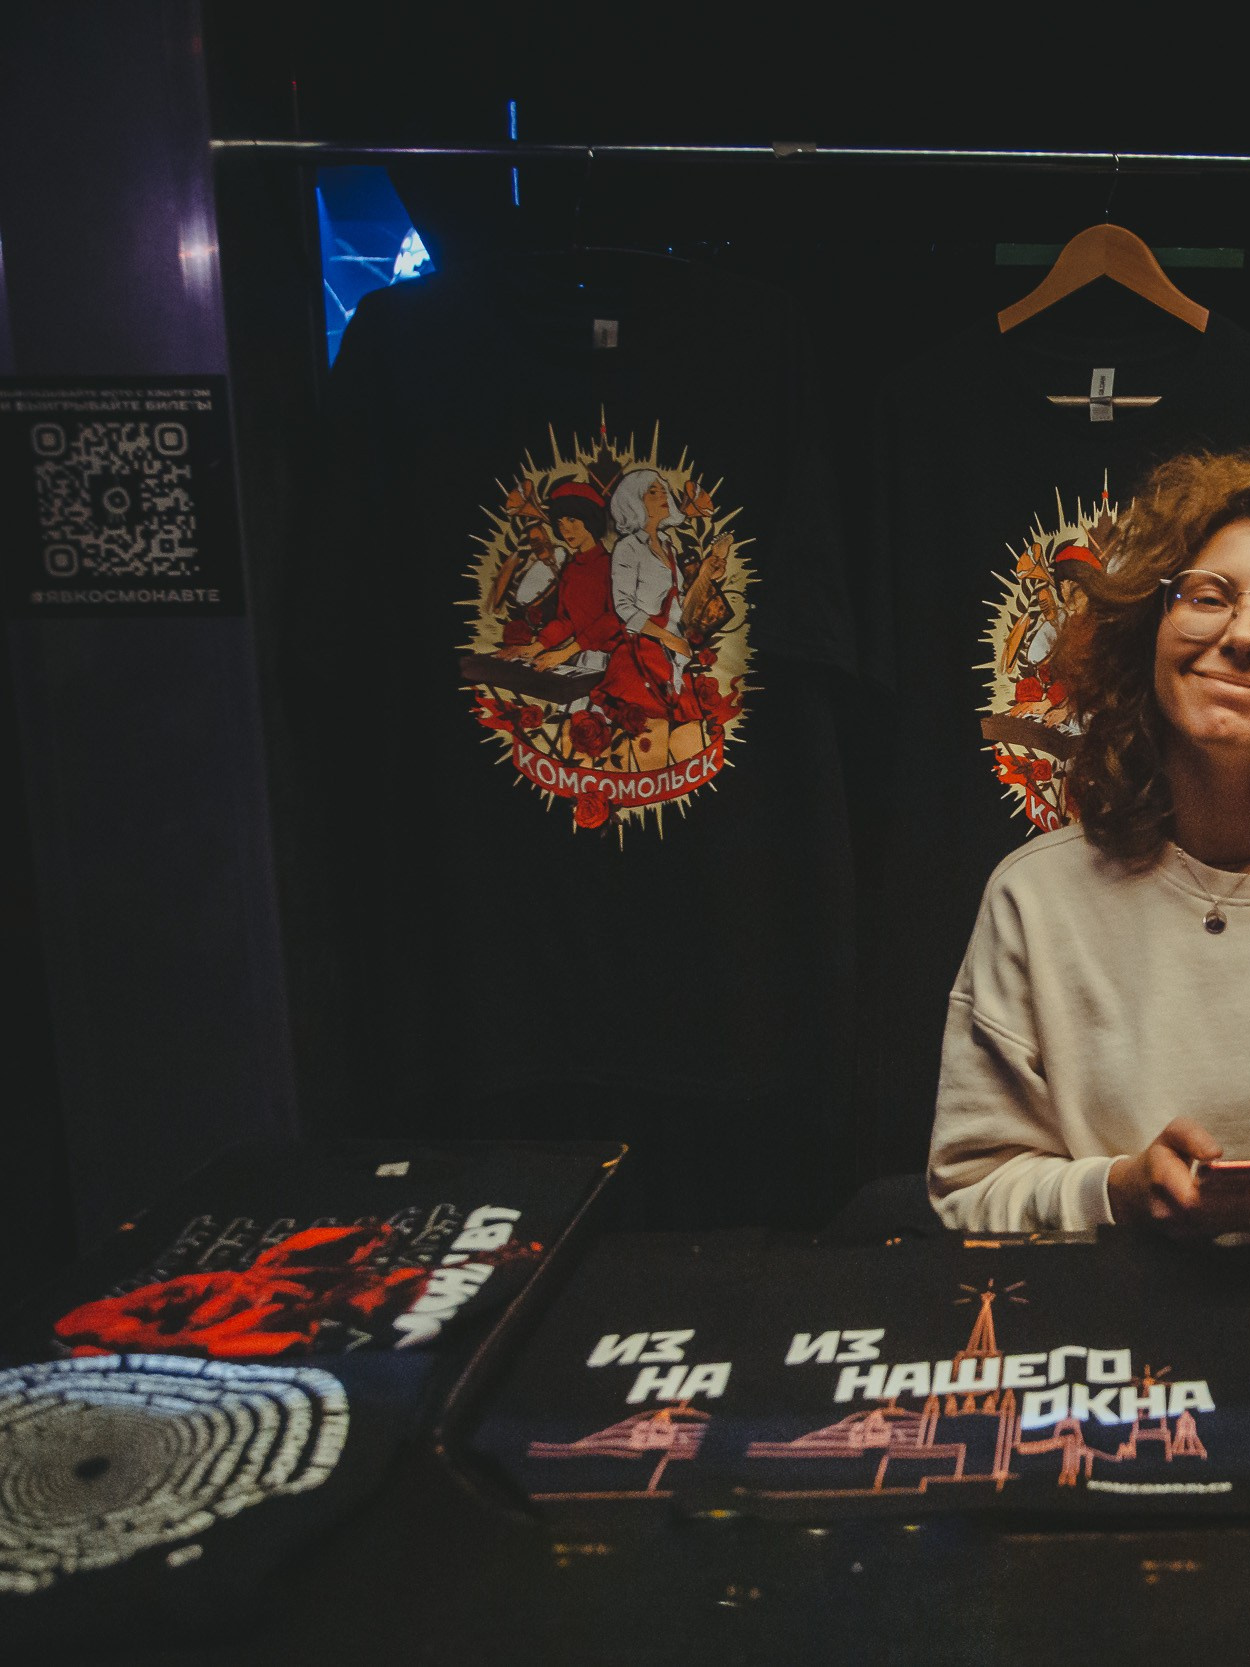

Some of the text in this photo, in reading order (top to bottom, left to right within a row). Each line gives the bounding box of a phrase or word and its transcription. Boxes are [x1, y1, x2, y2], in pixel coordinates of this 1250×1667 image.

[517, 743, 718, 799] КОМСОМОЛЬСК
[588, 1329, 695, 1368] ИЗ
[785, 1328, 886, 1365] ИЗ
[626, 1361, 732, 1404] НА
[834, 1346, 1132, 1404] НАШЕГО
[1020, 1381, 1216, 1431] ОКНА
